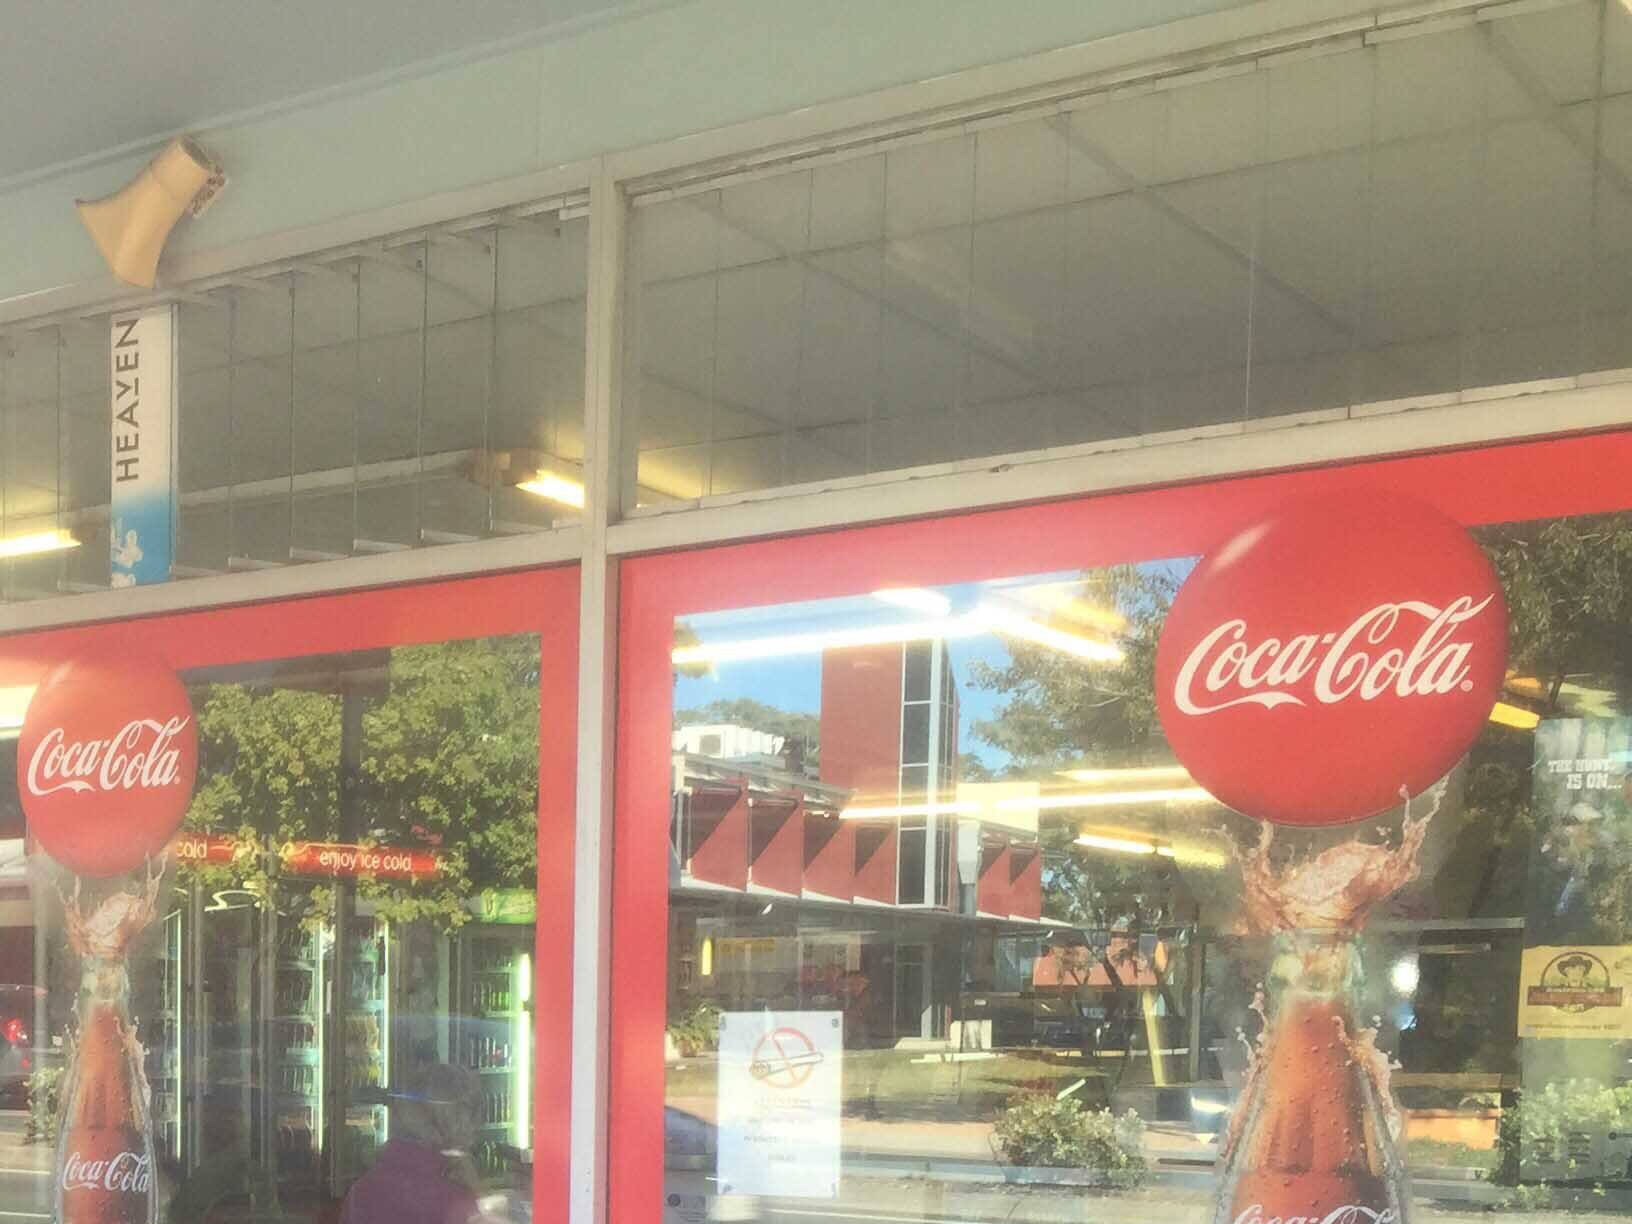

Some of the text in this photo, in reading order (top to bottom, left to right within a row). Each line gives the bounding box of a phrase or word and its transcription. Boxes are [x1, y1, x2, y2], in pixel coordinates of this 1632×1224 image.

[115, 318, 140, 483] HEAVEN
[1173, 592, 1495, 717] Coca-Cola
[27, 715, 190, 796] Coca-Cola
[318, 849, 357, 875] enjoy
[383, 852, 412, 873] cold
[62, 1151, 151, 1193] Coca-Cola
